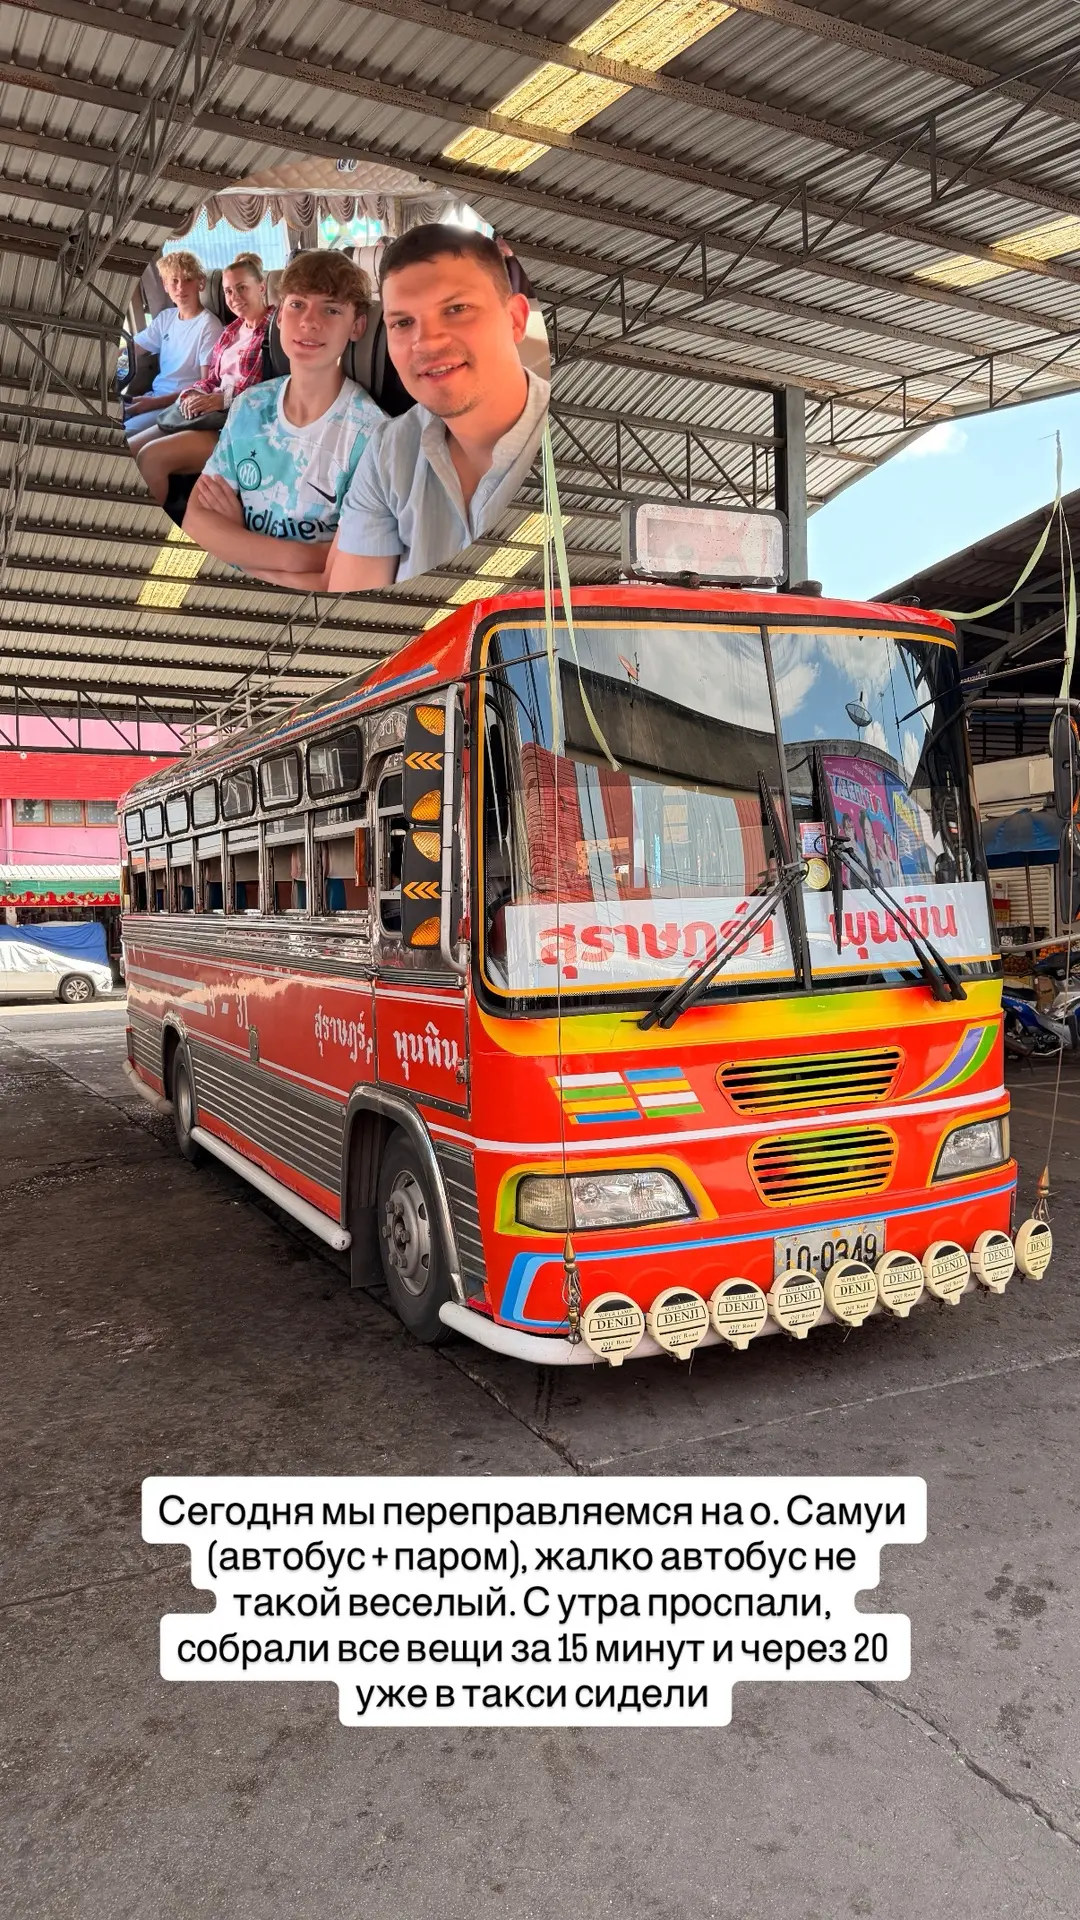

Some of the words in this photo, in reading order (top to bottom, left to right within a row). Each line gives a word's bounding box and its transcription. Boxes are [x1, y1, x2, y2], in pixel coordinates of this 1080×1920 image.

[786, 1233, 877, 1272] 10-0349
[987, 1249, 1010, 1262] DENJI
[936, 1258, 963, 1275] DENJI
[889, 1271, 917, 1284] DENJI
[840, 1282, 871, 1296] DENJI
[785, 1291, 817, 1304] DENJI
[725, 1301, 759, 1313] DENJI
[597, 1316, 633, 1329] DENJI
[664, 1308, 699, 1324] DENJI
